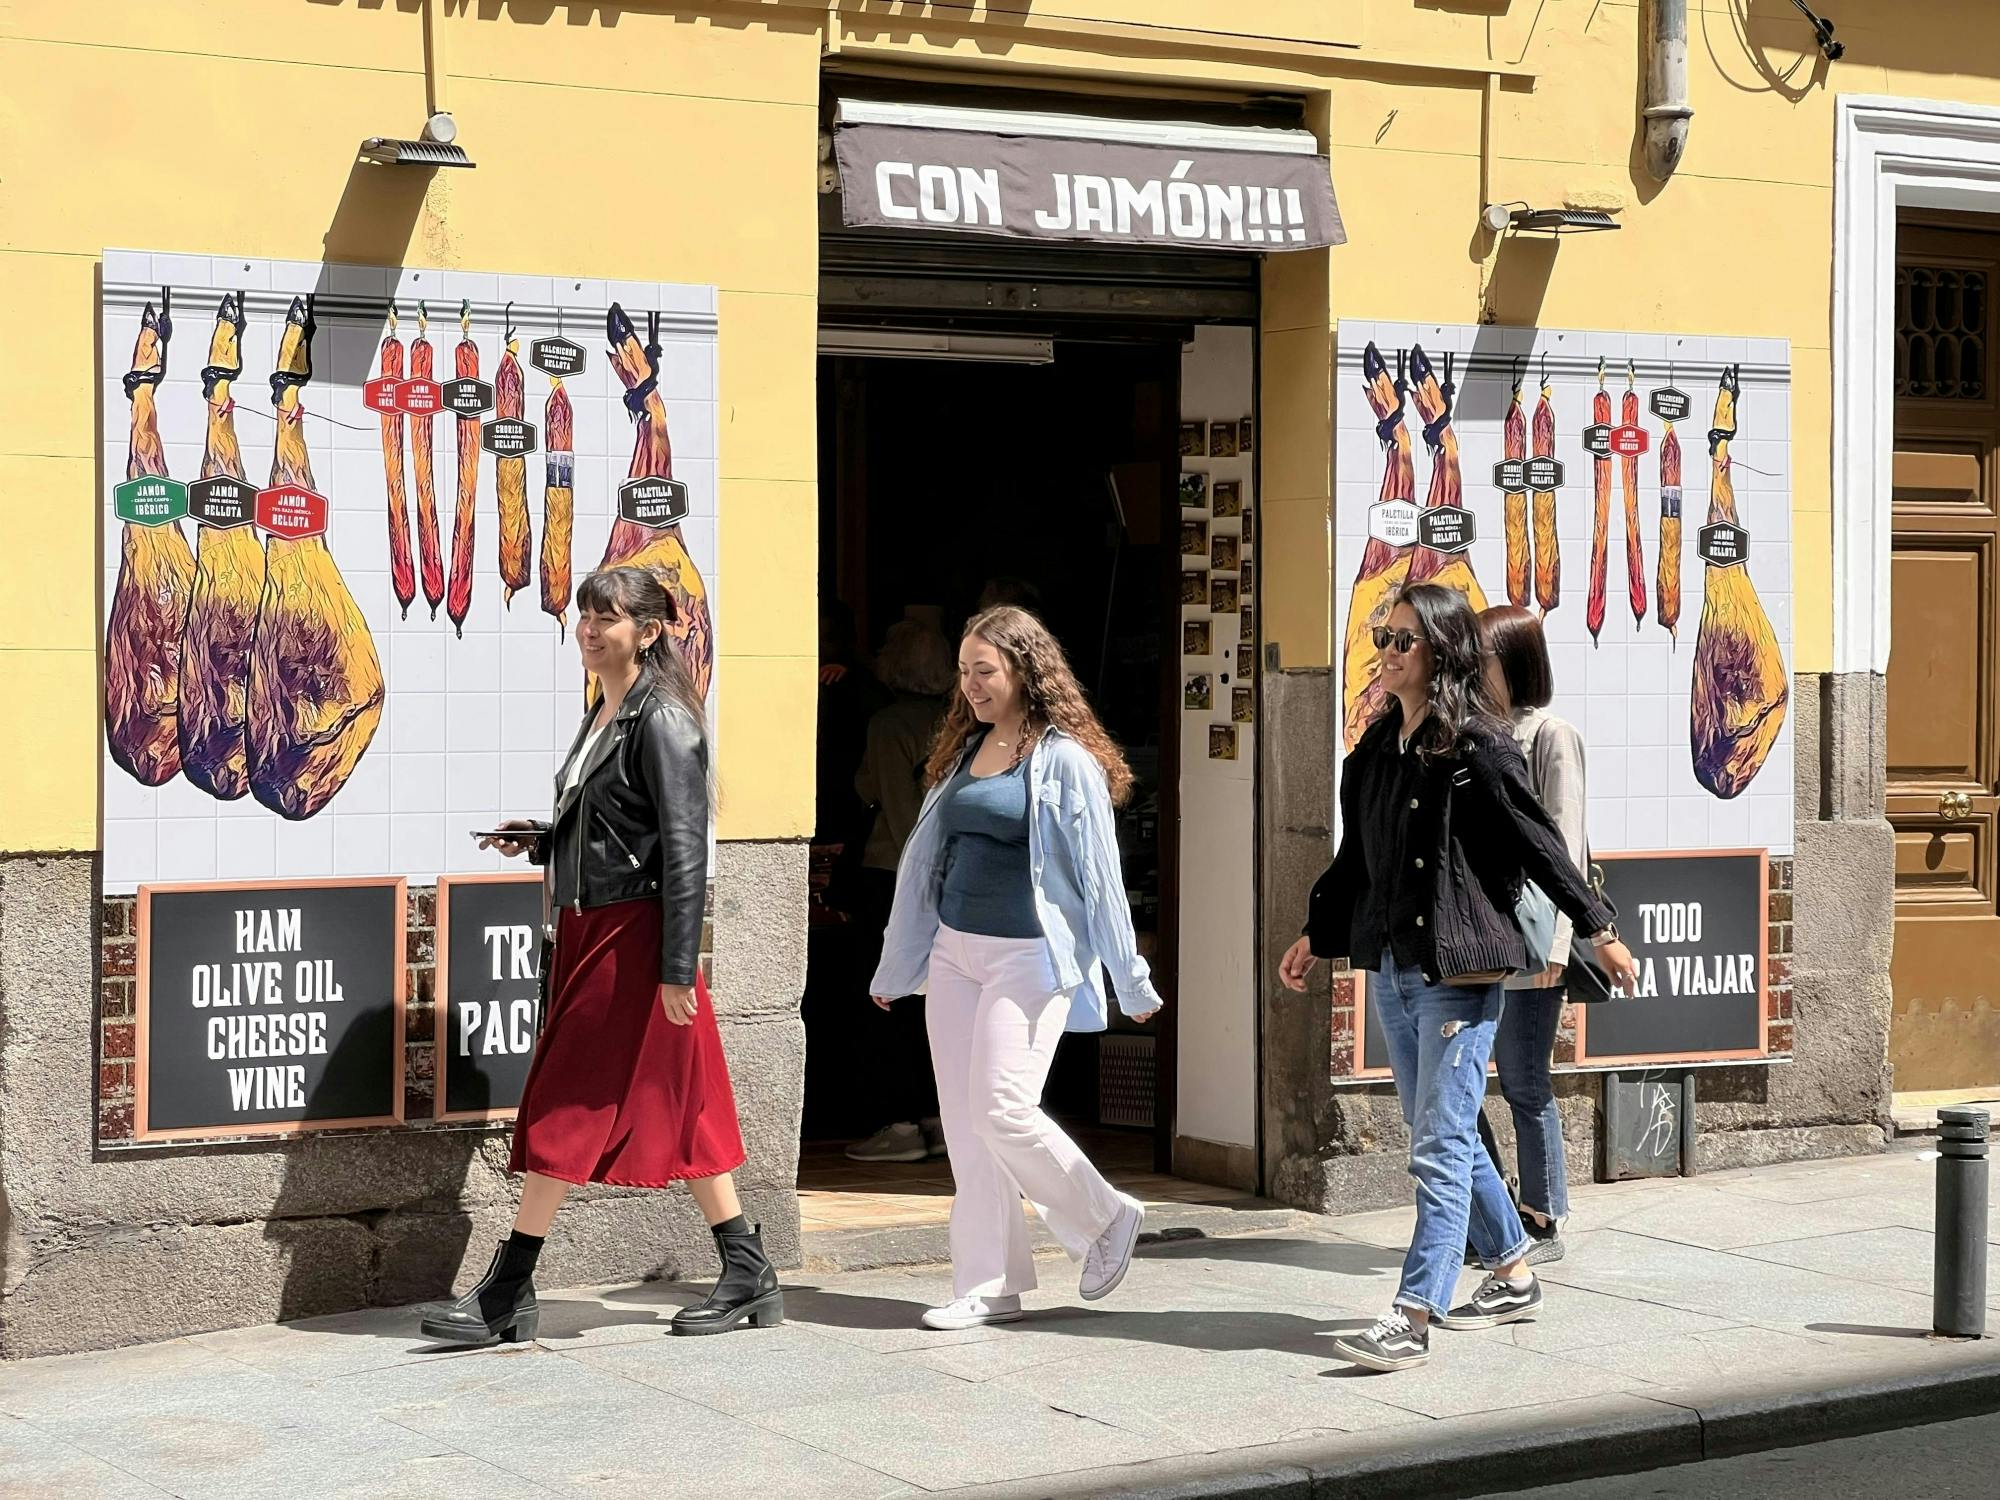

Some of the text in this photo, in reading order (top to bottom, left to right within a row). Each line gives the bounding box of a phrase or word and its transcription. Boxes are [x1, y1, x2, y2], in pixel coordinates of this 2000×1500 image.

[875, 159, 1306, 243] CON JAMÓN!!!
[540, 344, 577, 358] SALCHICHÓN
[544, 358, 571, 371] BELLOTA
[411, 384, 429, 394] LOMO
[458, 384, 476, 393] LOMO
[378, 397, 394, 407] IBÉR
[407, 398, 433, 409] IBÉRICO
[453, 397, 482, 408] BELLOTA
[495, 424, 523, 434] CHORIZO
[494, 439, 524, 450] BELLOTA
[137, 483, 166, 497] JAMÓN
[209, 484, 239, 498] JAMÓN
[632, 485, 673, 499] PALETILLA
[277, 494, 306, 508] JAMÓN
[135, 503, 170, 516] IBÉRICO
[204, 504, 243, 518] BELLOTA
[636, 504, 672, 518] BELLOTA
[1381, 508, 1414, 520] PALETILLA
[272, 513, 310, 529] BELLOTA
[1429, 513, 1463, 527] PALETILLA
[1385, 525, 1409, 537] IBÉRICA
[1432, 530, 1462, 544] BELLOTA
[1713, 529, 1735, 541] JAMÓN
[1709, 545, 1737, 558] BELLOTA
[1638, 902, 1702, 944] TODO
[234, 908, 302, 954] HAM
[484, 924, 541, 981] TR
[1666, 954, 1756, 997] VIAJAR
[191, 959, 344, 1009] OLIVE OIL
[207, 1011, 328, 1060] CHEESE
[226, 1064, 307, 1112] WINE
